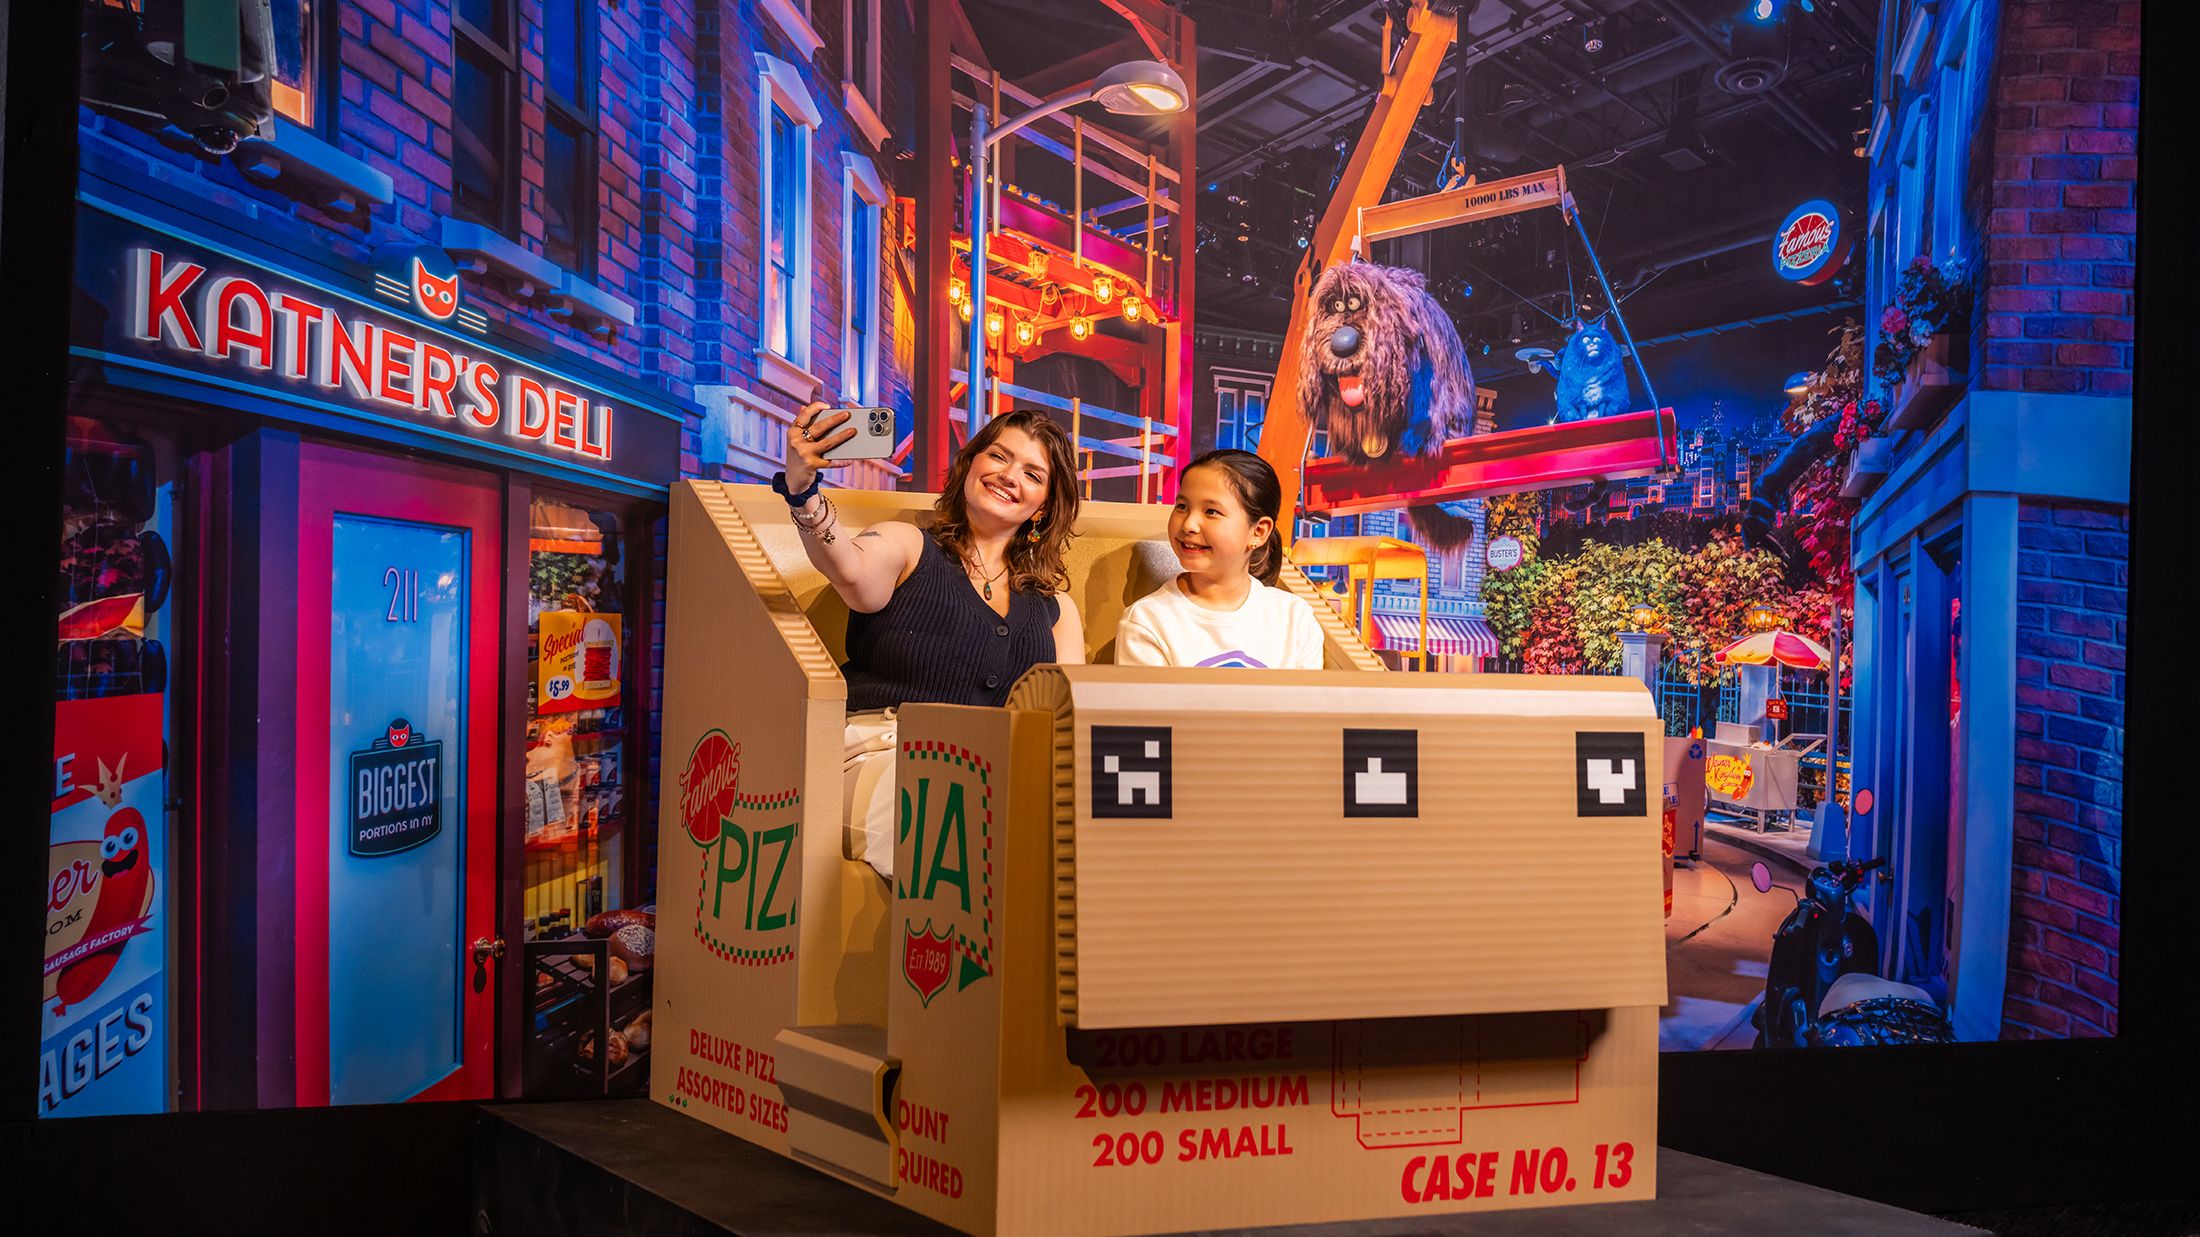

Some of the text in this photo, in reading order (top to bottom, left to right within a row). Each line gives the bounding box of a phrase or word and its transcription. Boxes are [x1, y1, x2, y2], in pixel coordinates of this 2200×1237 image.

[1465, 181, 1546, 208] 10000 LBS MAX
[1778, 220, 1835, 257] Famous
[134, 247, 613, 461] KATNER'S DELI
[1490, 548, 1518, 558] BUSTER'S
[383, 566, 419, 623] 211
[543, 617, 587, 664] Special
[549, 680, 570, 698] $5.99
[358, 757, 437, 820] BIGGEST
[680, 742, 741, 828] Famous
[43, 923, 136, 974] SAUSAGE FACTORY
[924, 949, 947, 975] 1989
[690, 1028, 742, 1072] DELUXE
[1094, 1027, 1293, 1068] 200 LARGE
[676, 1066, 790, 1134] ASSORTED SIZES
[1073, 1074, 1310, 1119] 200 MEDIUM
[1091, 1123, 1294, 1168] 200 SMALL
[1401, 1141, 1635, 1205] CASE NO. 13
